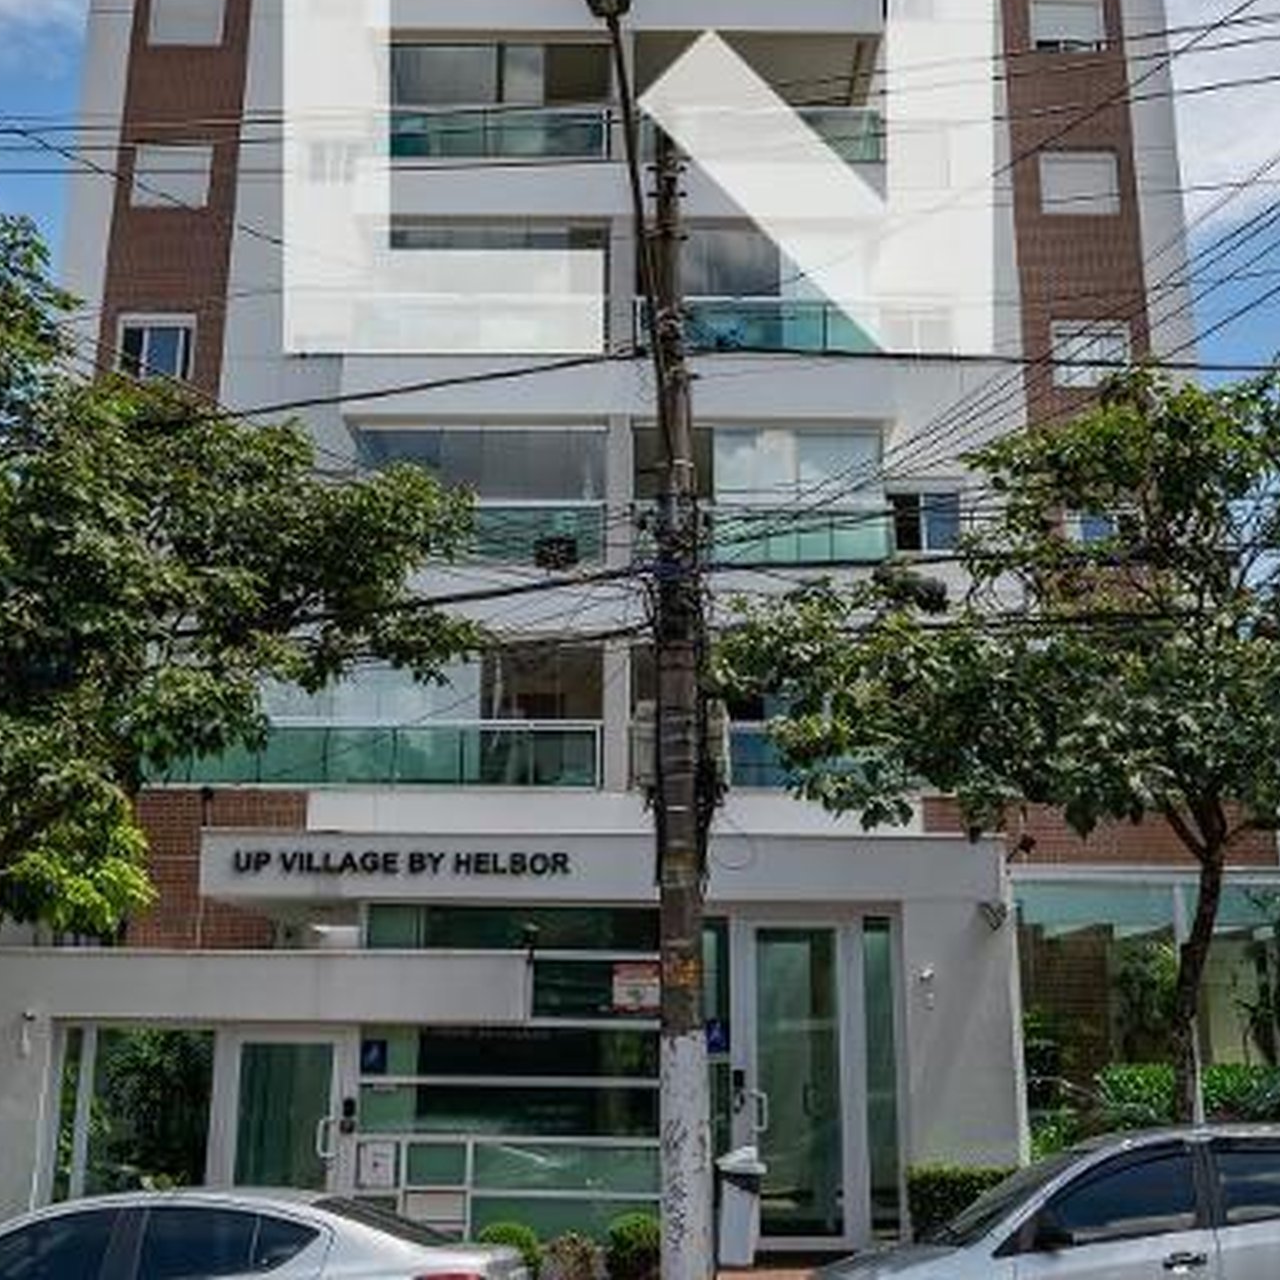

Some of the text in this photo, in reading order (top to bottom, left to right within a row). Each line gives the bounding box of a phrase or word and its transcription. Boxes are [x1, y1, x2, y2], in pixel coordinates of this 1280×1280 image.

[233, 850, 570, 876] UP VILLAGE BY HELBOR
